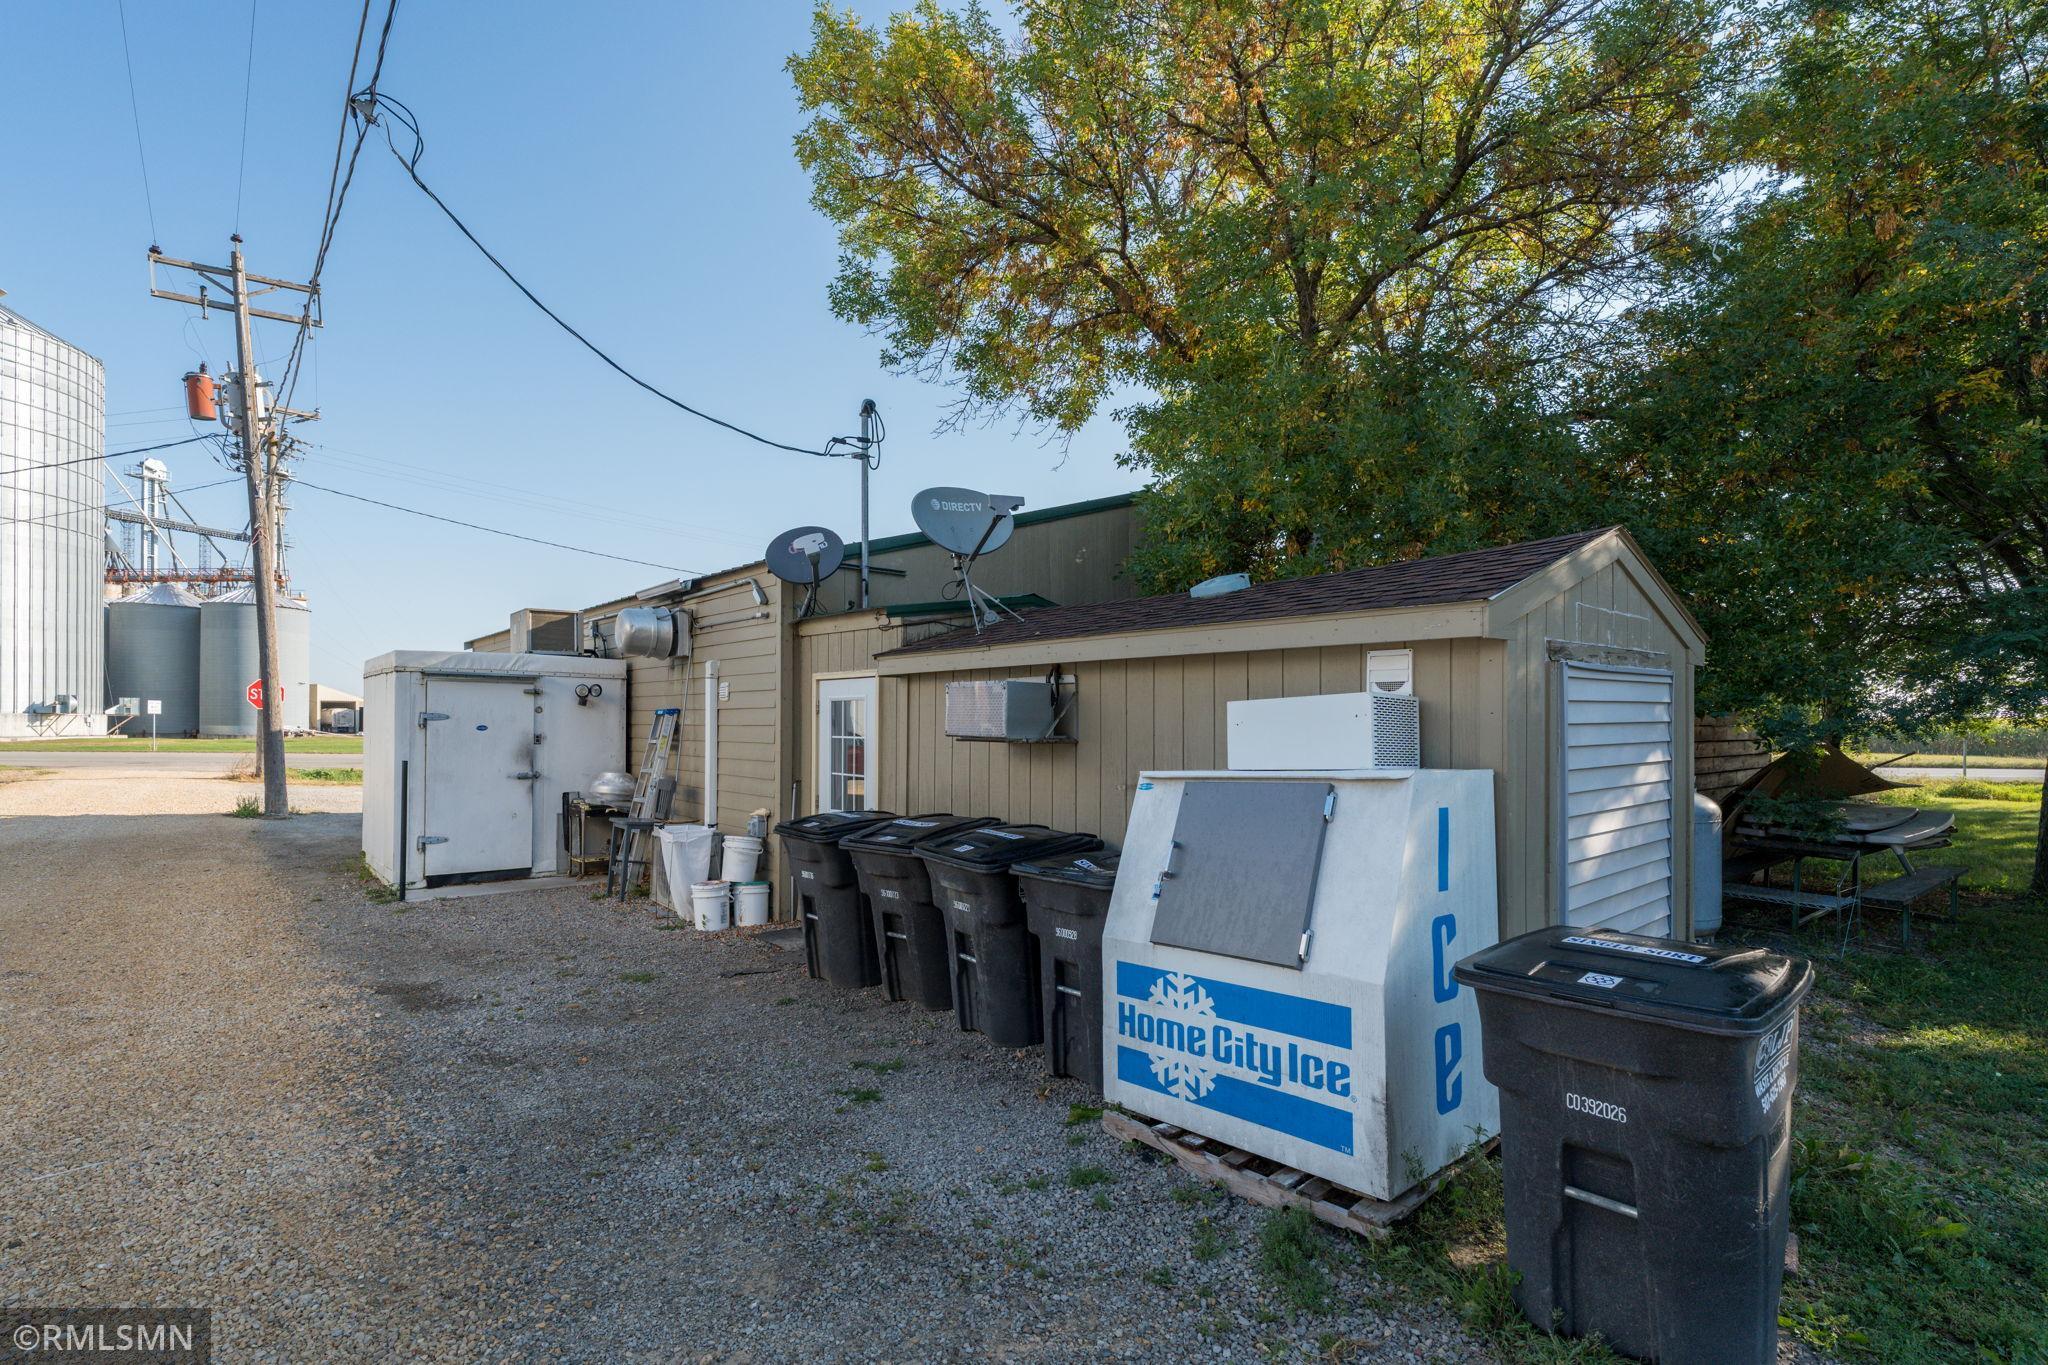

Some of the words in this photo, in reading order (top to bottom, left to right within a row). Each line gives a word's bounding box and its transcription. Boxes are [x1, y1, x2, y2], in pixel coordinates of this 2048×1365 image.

[941, 501, 982, 512] DIRECTV
[1567, 937, 1639, 951] SINGLE
[1643, 949, 1703, 960] SORT
[1118, 1001, 1206, 1058] Home
[1212, 1024, 1281, 1087] City
[1288, 1042, 1350, 1098] Ice
